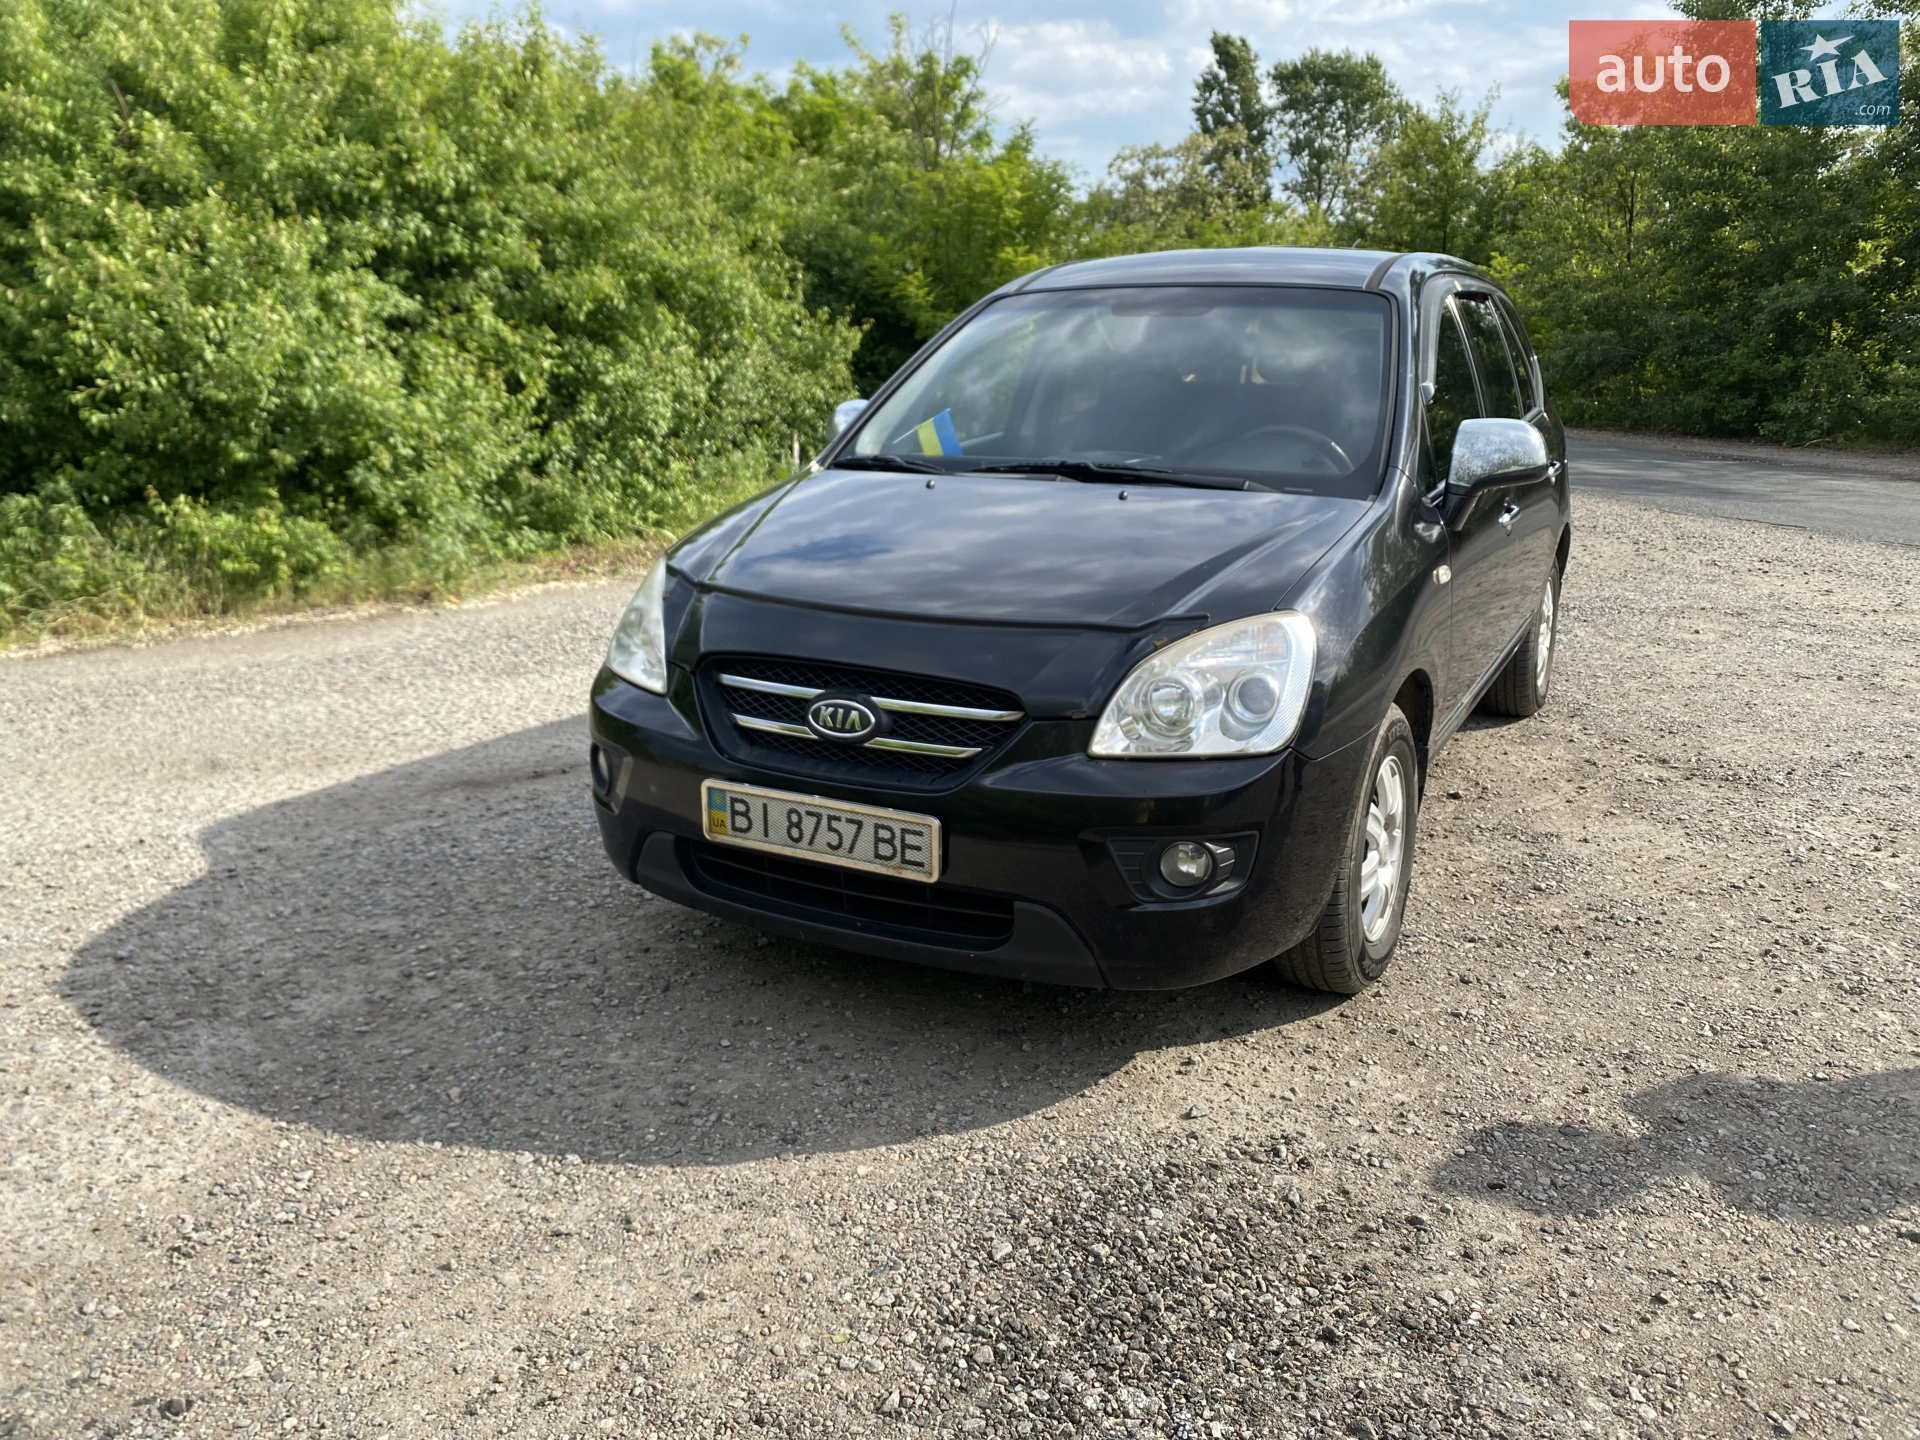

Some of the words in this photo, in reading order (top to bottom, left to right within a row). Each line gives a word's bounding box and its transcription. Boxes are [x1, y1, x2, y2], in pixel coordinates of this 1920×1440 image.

[818, 705, 862, 731] KIA
[712, 816, 726, 829] UA
[730, 796, 769, 838] BI
[786, 808, 864, 854] 8757
[873, 822, 925, 868] BE
